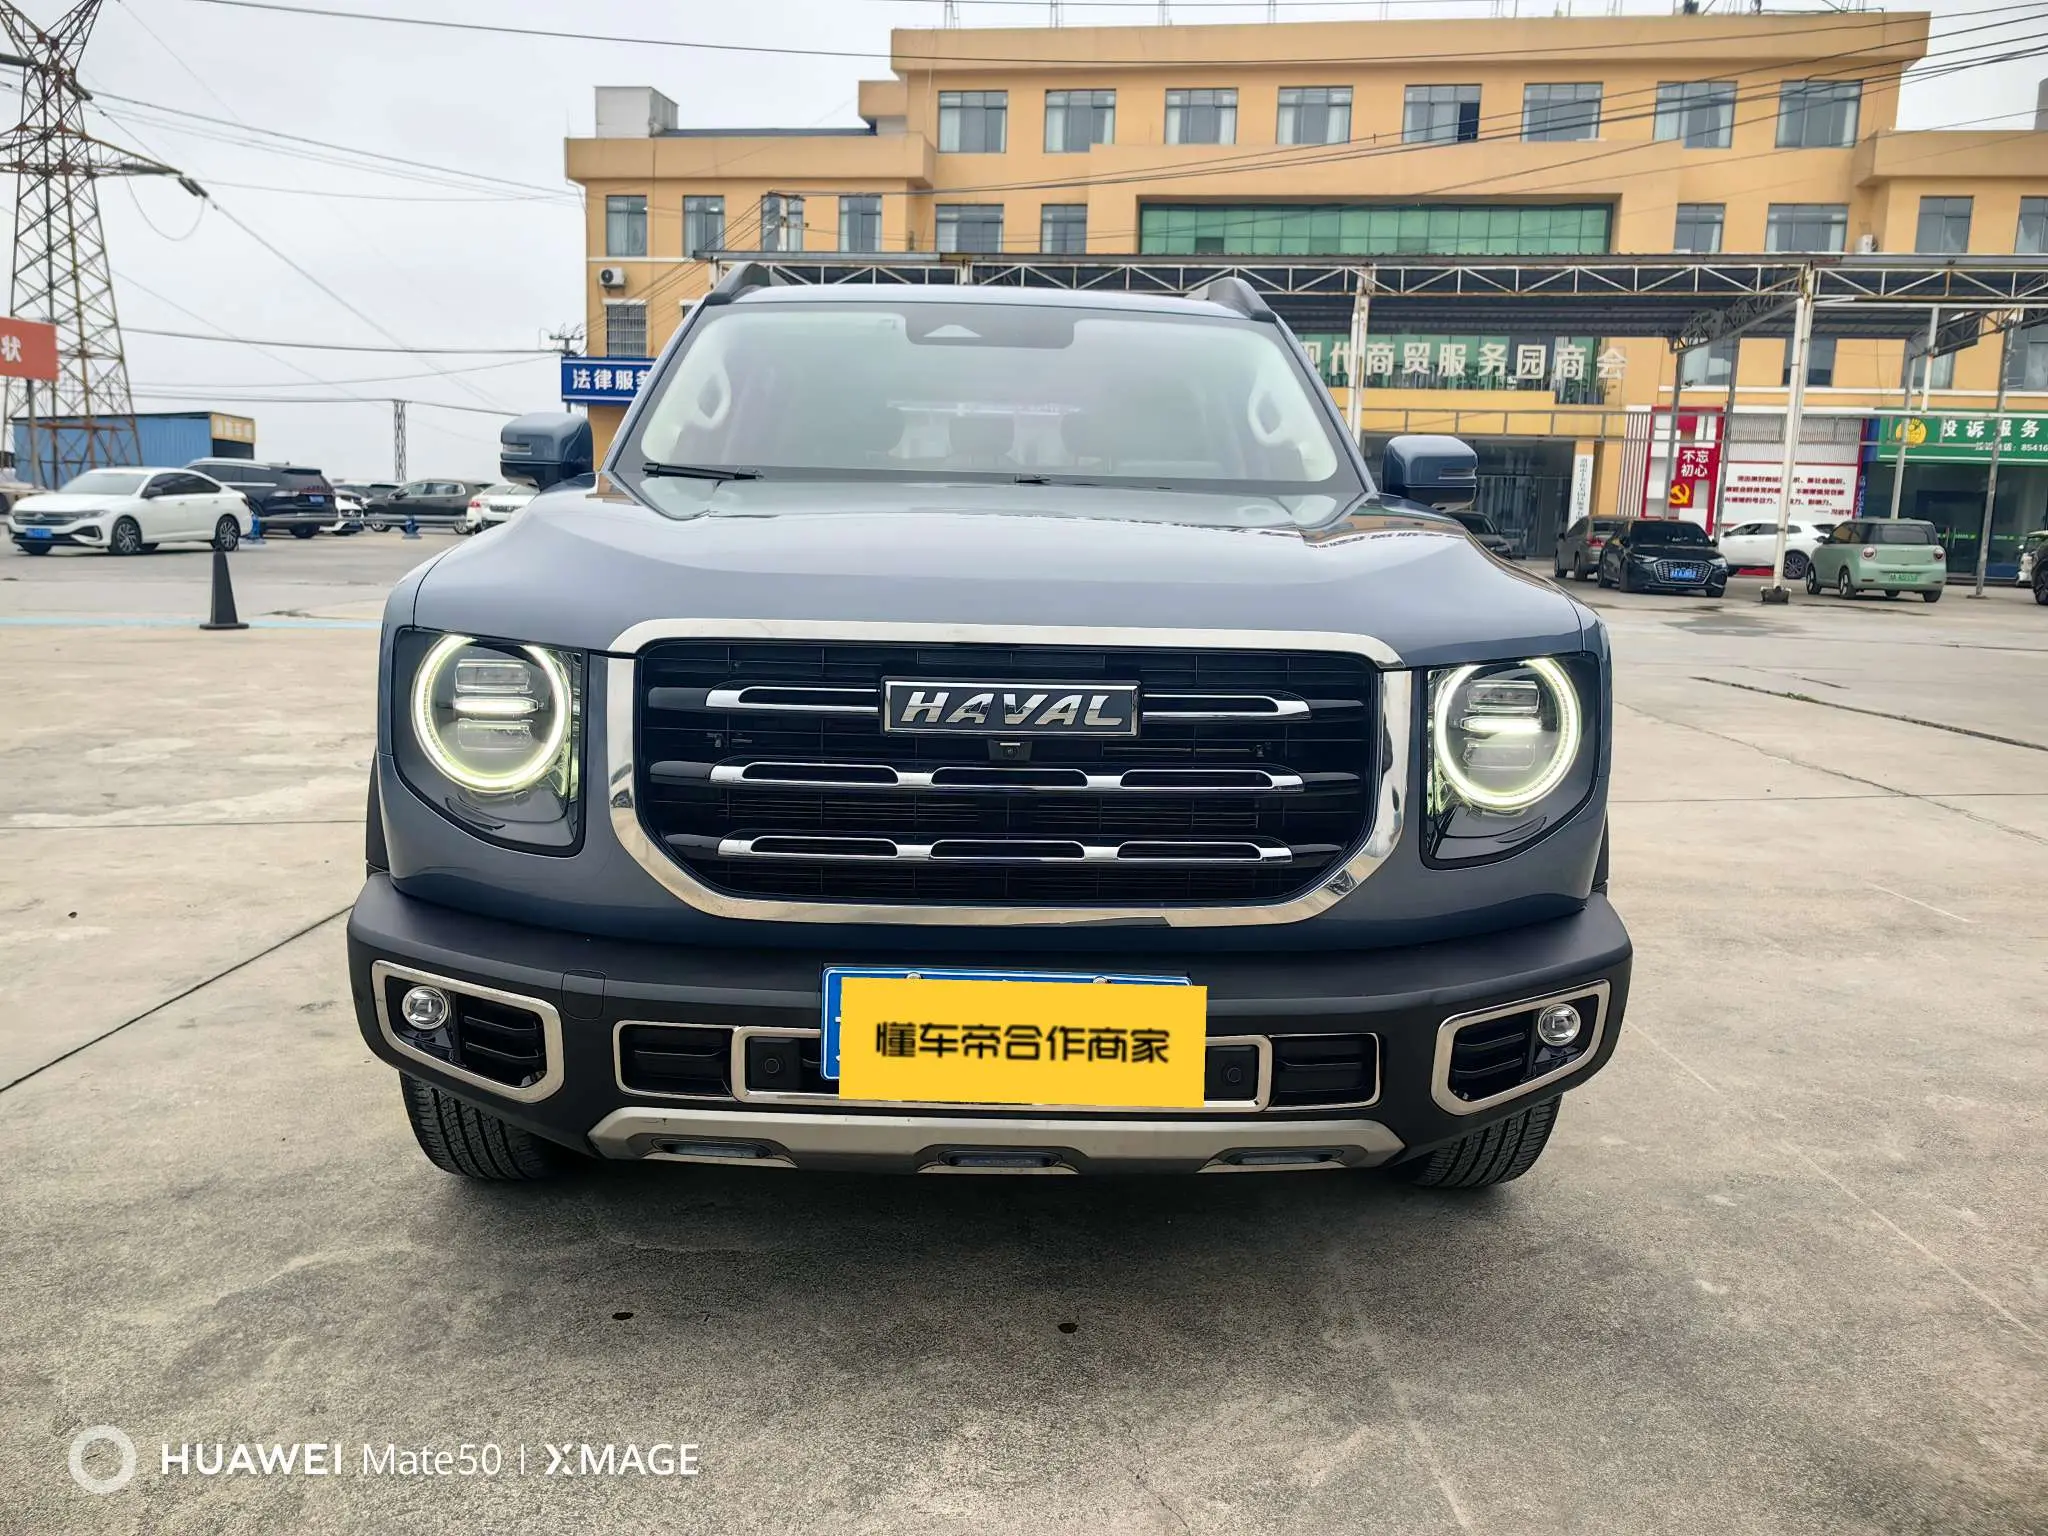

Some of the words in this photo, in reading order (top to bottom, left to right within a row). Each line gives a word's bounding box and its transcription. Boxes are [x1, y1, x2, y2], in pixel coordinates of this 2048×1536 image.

[1, 335, 22, 363] 状
[1682, 450, 1709, 464] 不忘
[1681, 463, 1708, 477] 初心
[900, 691, 1122, 726] HAVAL
